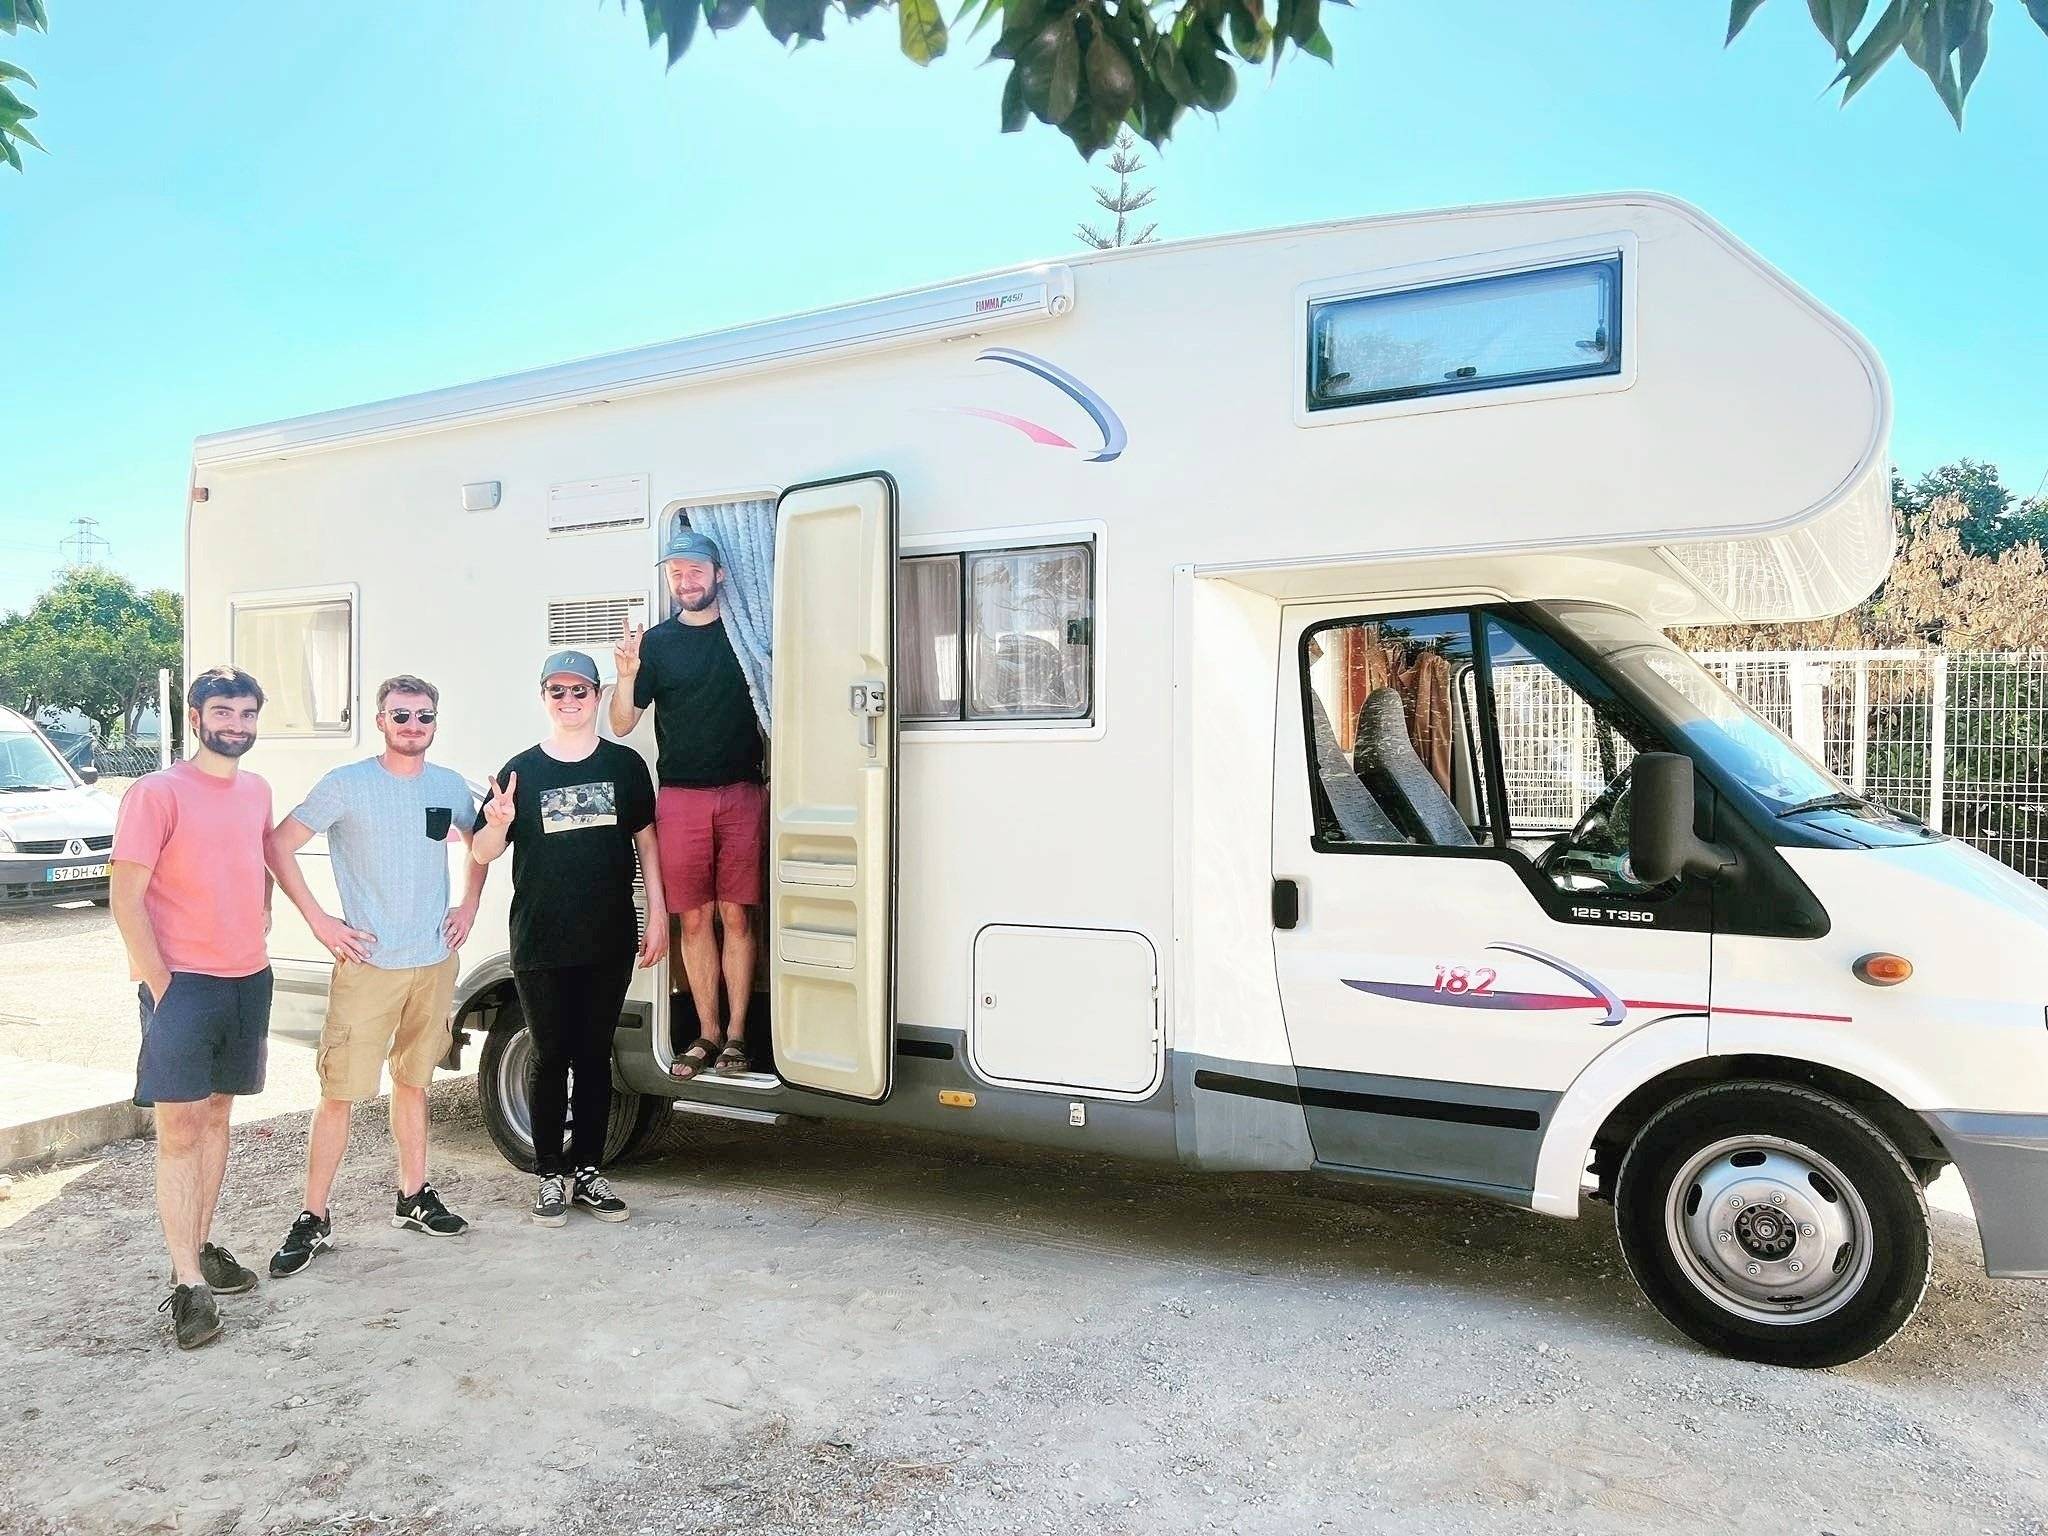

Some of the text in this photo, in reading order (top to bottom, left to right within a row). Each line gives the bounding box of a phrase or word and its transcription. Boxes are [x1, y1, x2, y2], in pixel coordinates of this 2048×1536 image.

[975, 297, 1000, 313] FIAMMA
[1571, 907, 1654, 922] 125 T350
